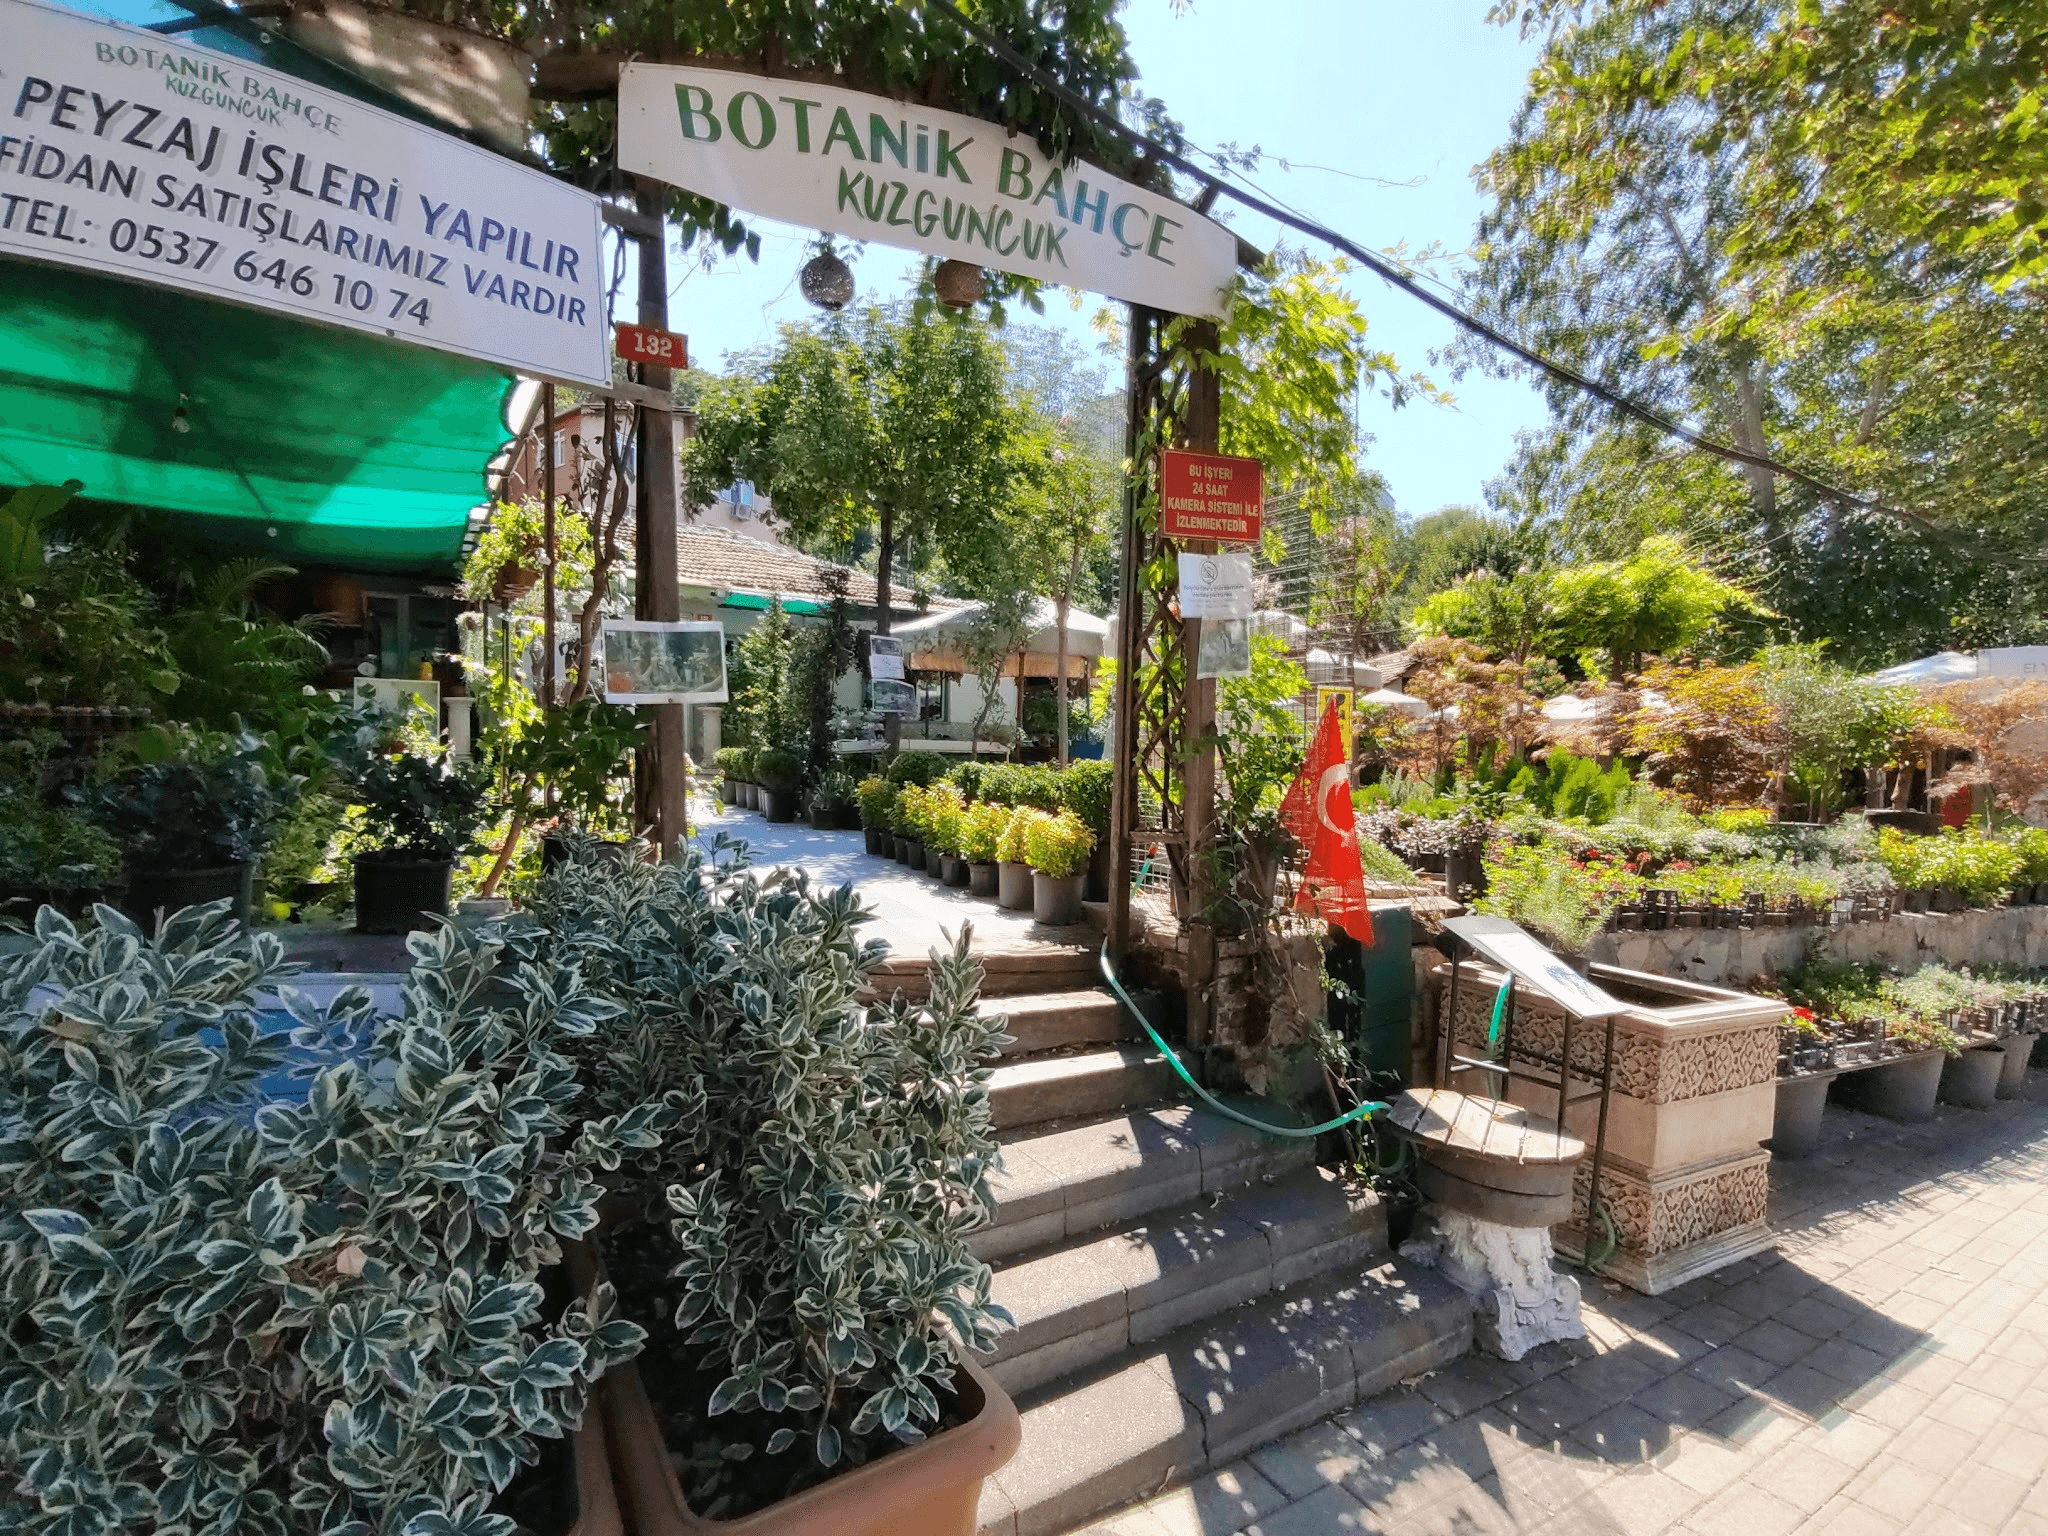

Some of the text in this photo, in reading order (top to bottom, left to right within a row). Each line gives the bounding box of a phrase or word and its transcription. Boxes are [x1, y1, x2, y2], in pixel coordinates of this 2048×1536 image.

[166, 74, 281, 126] KUZGUNCUK
[243, 76, 342, 136] BAHÇE
[13, 76, 579, 284] PEYZAJ İŞLERİ YAPILIR
[996, 147, 1184, 267] BAHÇE
[0, 135, 586, 326] FİDAN SATIŞLARIMIZ VARDIR
[838, 166, 1069, 268] KUZGUNCUK
[2, 193, 430, 327] TEL: 0537 646 10 74
[634, 331, 672, 358] 132
[1189, 464, 1202, 477] BU
[1193, 482, 1228, 497] 24 SAAT
[1168, 497, 1206, 512] KAMERA
